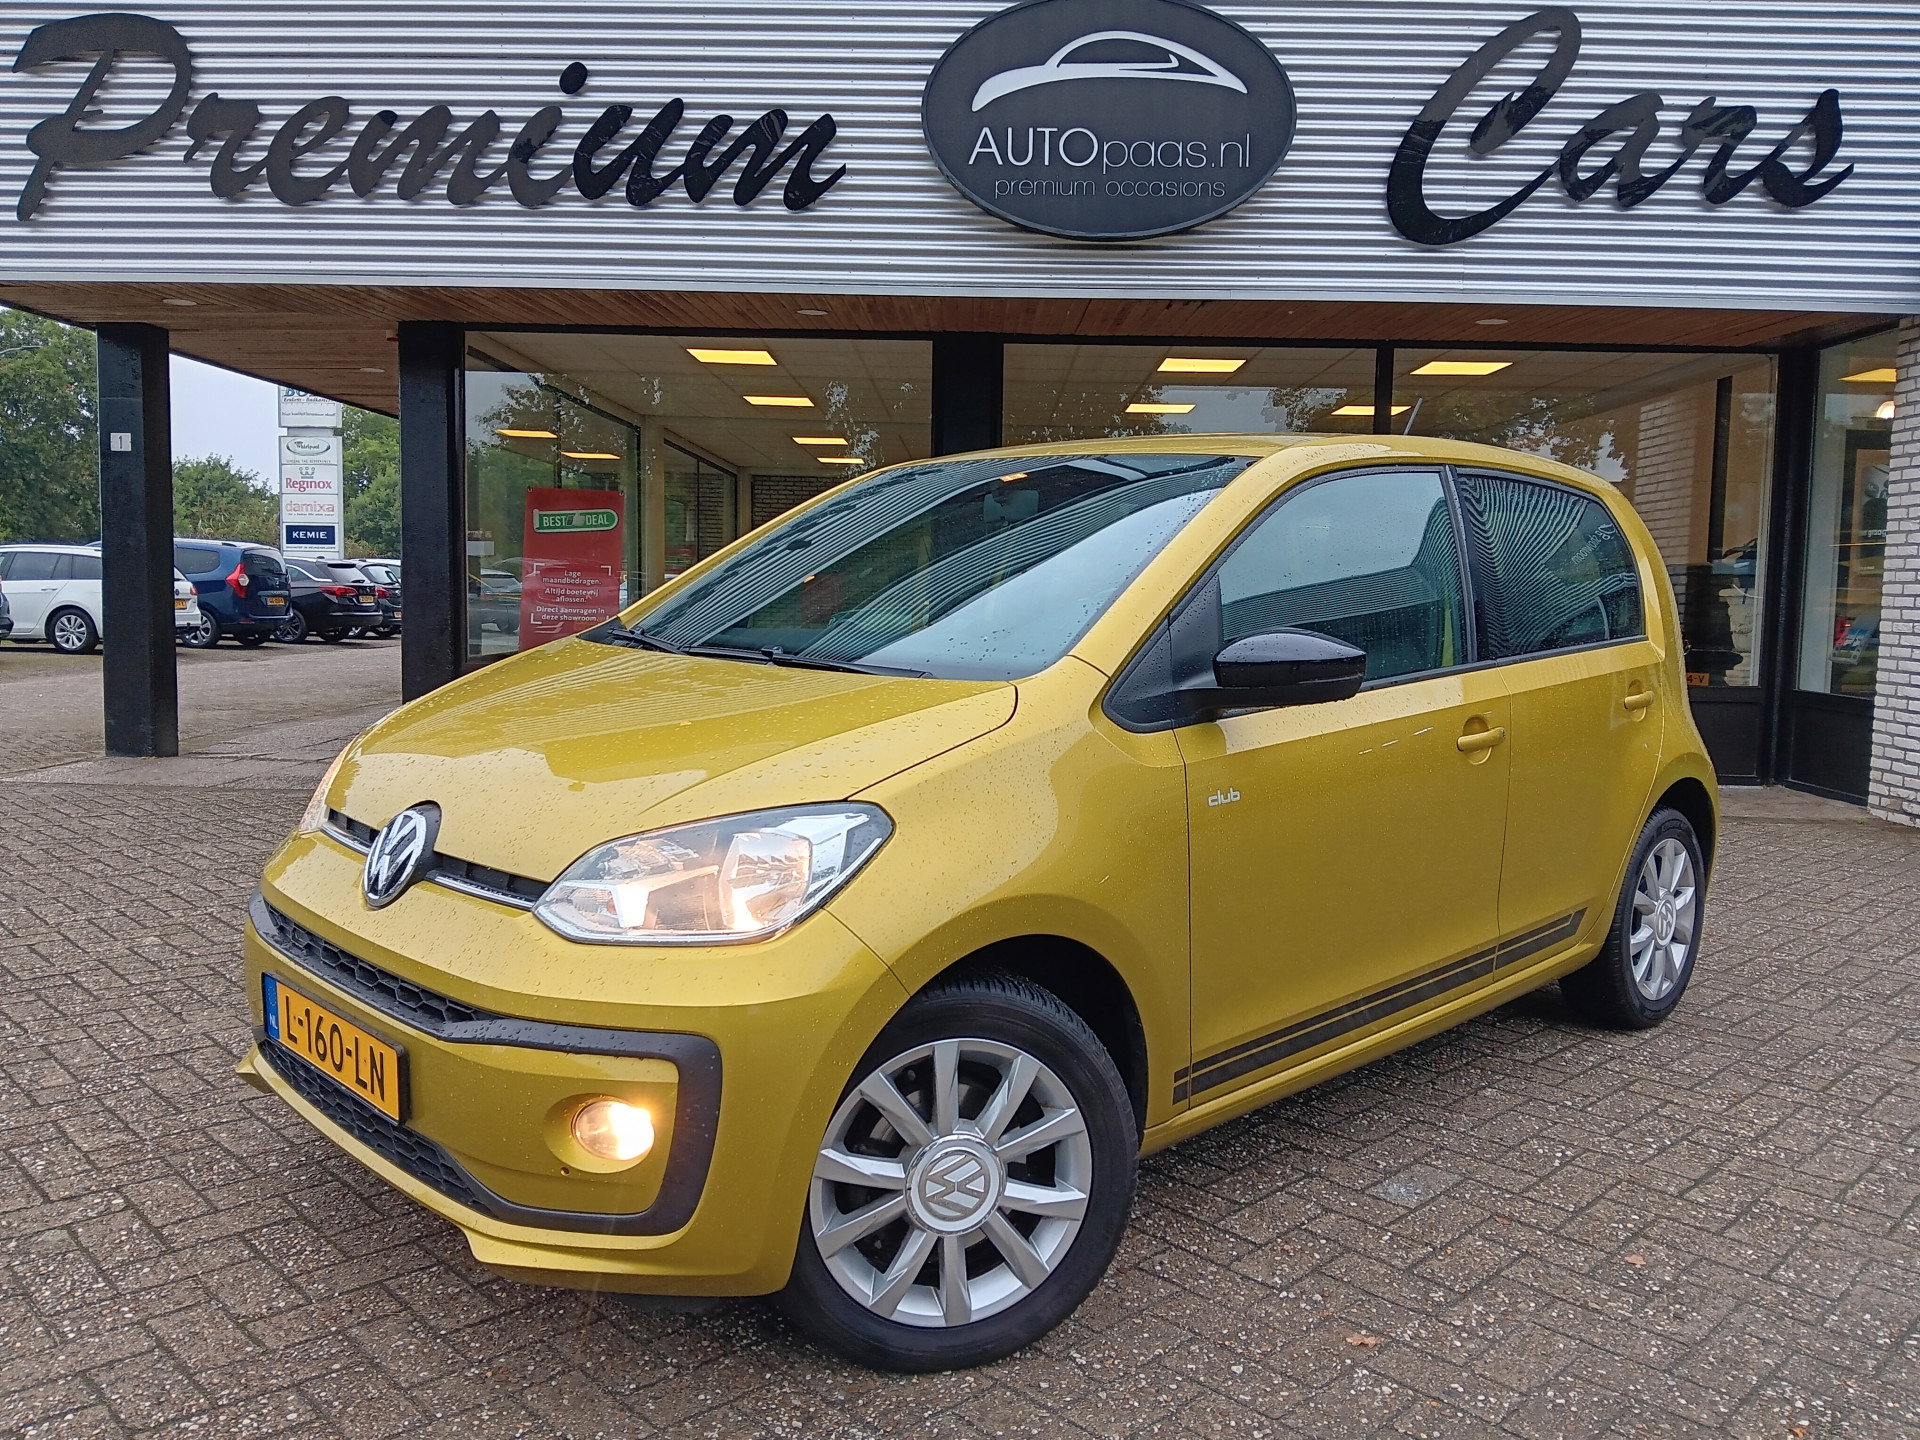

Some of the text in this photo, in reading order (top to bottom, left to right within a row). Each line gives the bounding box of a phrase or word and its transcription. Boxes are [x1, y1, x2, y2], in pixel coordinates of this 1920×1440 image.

[12, 5, 1855, 246] Premium Cars
[968, 126, 1251, 175] AUTOpaas.nl
[995, 175, 1226, 200] premium occasions
[118, 435, 123, 450] 1
[285, 477, 332, 493] Reginox
[285, 500, 335, 512] damixa
[542, 513, 610, 527] BEST DEAL
[292, 530, 328, 539] KEMIE
[564, 570, 582, 579] Lage
[542, 577, 602, 587] maandbedragen.
[544, 587, 566, 596] Altijd
[536, 605, 559, 613] Direct
[559, 607, 597, 616] aanvragen
[541, 613, 599, 622] deze showroom.
[1207, 787, 1241, 807] club
[269, 1013, 279, 1030] NL
[285, 994, 386, 1103] L-160-LN
